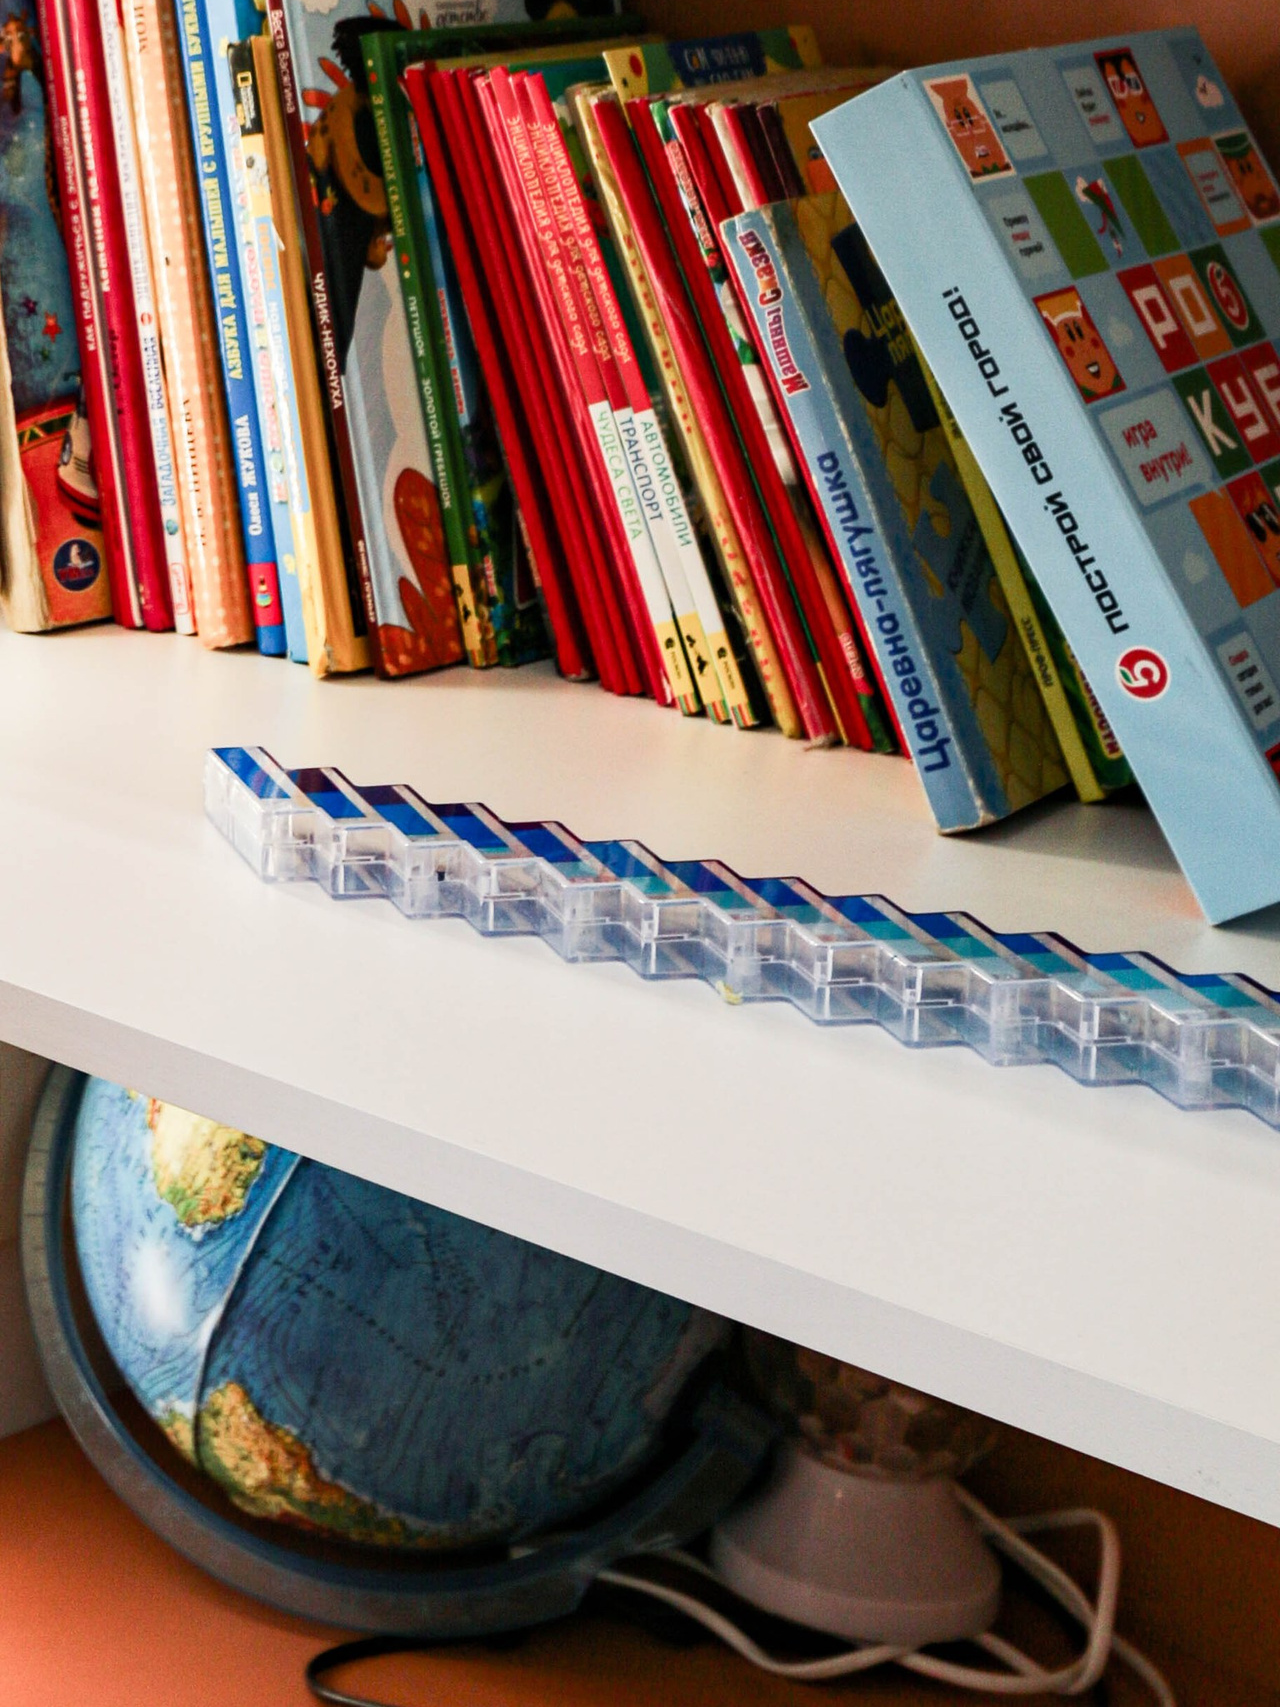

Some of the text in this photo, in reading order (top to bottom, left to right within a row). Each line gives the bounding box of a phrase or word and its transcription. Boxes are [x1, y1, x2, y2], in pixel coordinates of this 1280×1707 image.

[269, 9, 288, 49] Веста
[188, 59, 213, 156] КРУПНЫМИ
[202, 160, 216, 173] С
[387, 184, 406, 237] СКАЗКИ
[68, 214, 93, 319] ПОДРУЖИТЬСЯ
[201, 176, 228, 268] МАЛЫШЕЙ
[507, 116, 587, 356] ЭНЦИКЛОПЕДИЯ для детского сада
[528, 122, 611, 361] ЭНЦИКЛОПЕДИЯ для детского сада
[543, 121, 631, 363] ЭНЦИКЛОПЕДИЯ для детского сада
[83, 324, 96, 351] КАК
[215, 272, 236, 310] ДЛЯ
[309, 271, 346, 409] ЧУДИК-НЕХОЧУХА
[738, 230, 811, 395] Машины Сказки
[941, 286, 1009, 396] ГОРОД!
[221, 314, 242, 380] АЗБУКА
[141, 337, 177, 506] ЗАГАДОЧНАЯ ВСЕЛЕННАЯ
[406, 296, 426, 357] ПЕТУШОК
[421, 376, 442, 439] ЗОЛОТОЙ
[432, 441, 453, 509] ГРЕБЕШОК
[998, 401, 1054, 485] СВОЙ
[1122, 418, 1158, 449] игра
[233, 413, 262, 536] Олеся ЖУКОВА
[597, 411, 644, 540] ЧУДЕСА СВЕТА
[620, 417, 664, 522] ТРАНСПОРТ
[641, 421, 693, 547] АВТОМОБИЛИ
[1138, 441, 1194, 483] внутри!
[817, 451, 951, 773] Царевна-лягушка
[1043, 491, 1129, 635] ПОСТРОЙ
[1021, 616, 1054, 687] ПРОФ-ПРЕСС
